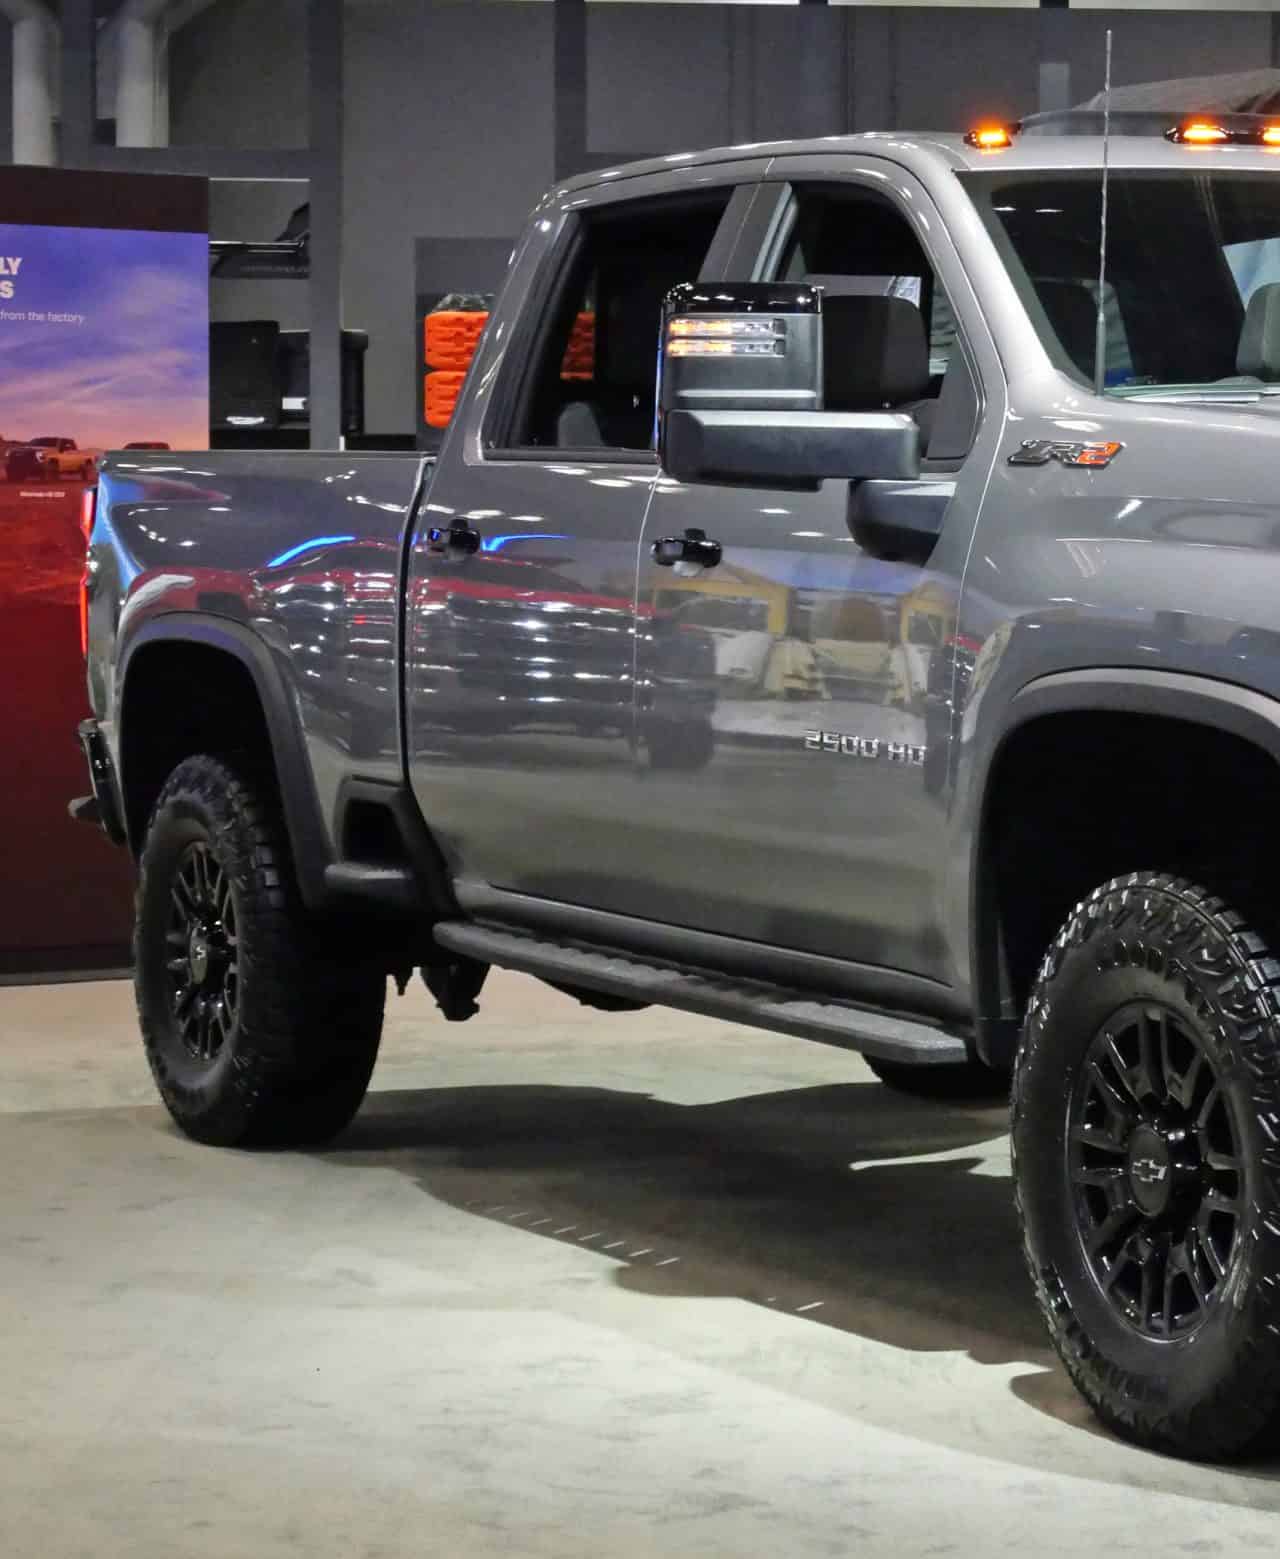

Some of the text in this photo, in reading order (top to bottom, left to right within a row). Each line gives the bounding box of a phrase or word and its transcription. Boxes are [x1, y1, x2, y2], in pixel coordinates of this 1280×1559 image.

[0, 310, 85, 324] from the factory
[803, 729, 927, 767] 2500 HD
